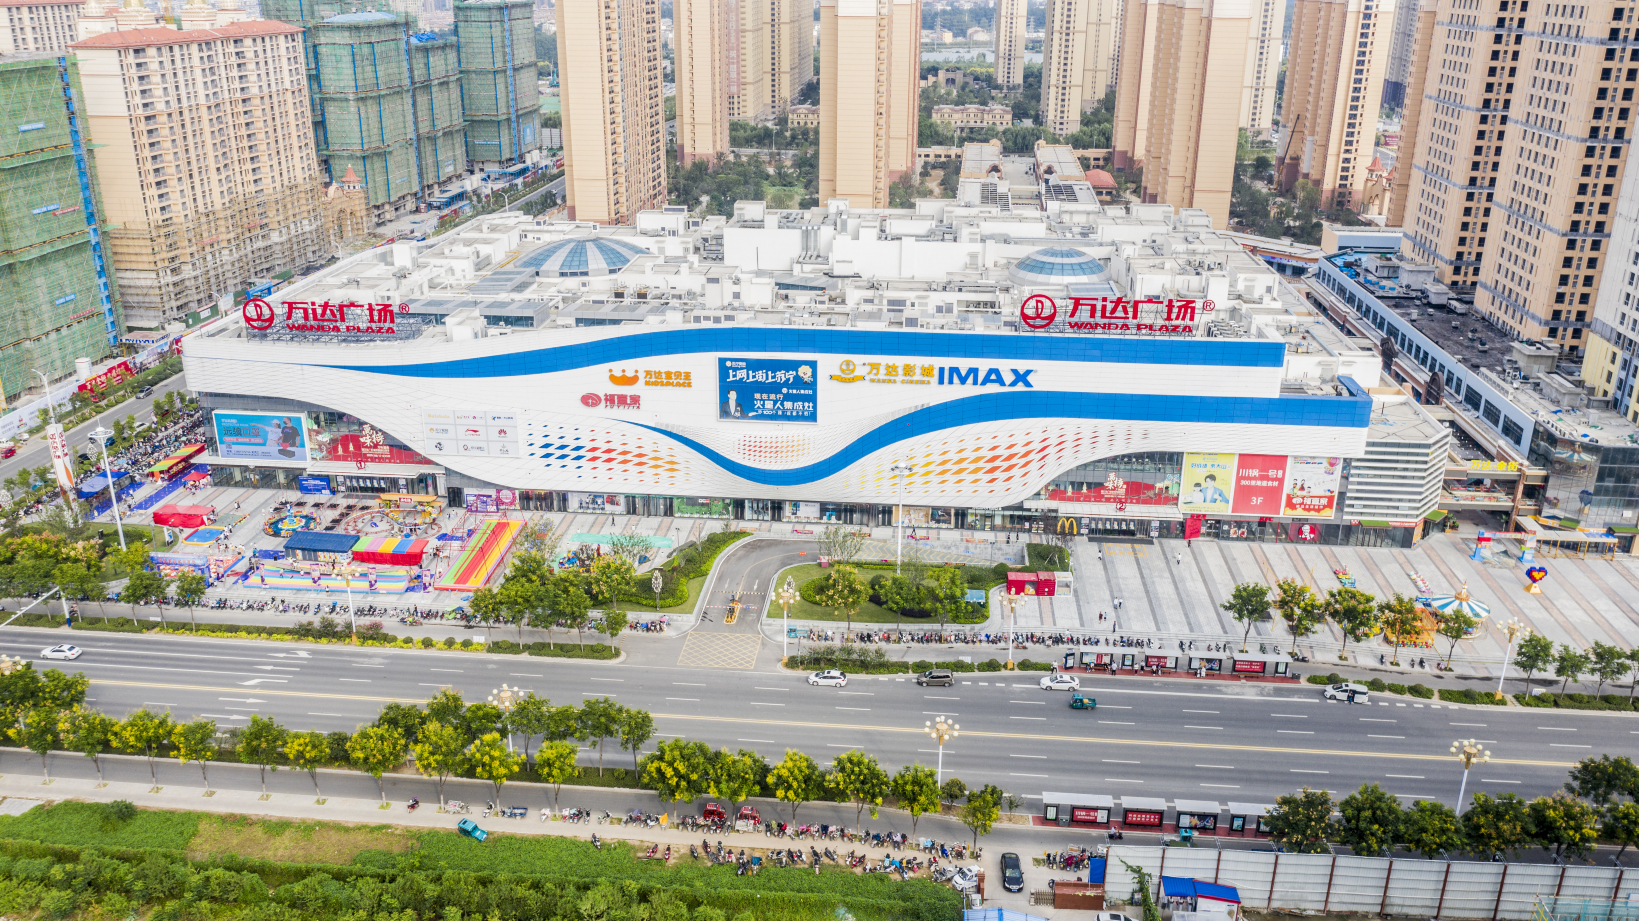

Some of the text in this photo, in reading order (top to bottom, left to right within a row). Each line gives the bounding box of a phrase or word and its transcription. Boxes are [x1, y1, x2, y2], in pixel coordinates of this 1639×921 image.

[282, 301, 396, 324] 万达广场
[1068, 296, 1196, 322] 万达广场
[286, 323, 396, 334] WANDA PLAZA
[1068, 321, 1193, 333] WANDA PLAZA
[644, 370, 692, 381] 万达宝贝王
[867, 362, 935, 378] 万达影城
[726, 368, 797, 384] 上网上街上苏宁
[938, 366, 1034, 388] IMAX
[753, 393, 784, 401] 现在流行
[753, 400, 814, 411] 火星人集成灶
[1238, 468, 1278, 478] 川锅一号
[1250, 496, 1264, 505] 3F
